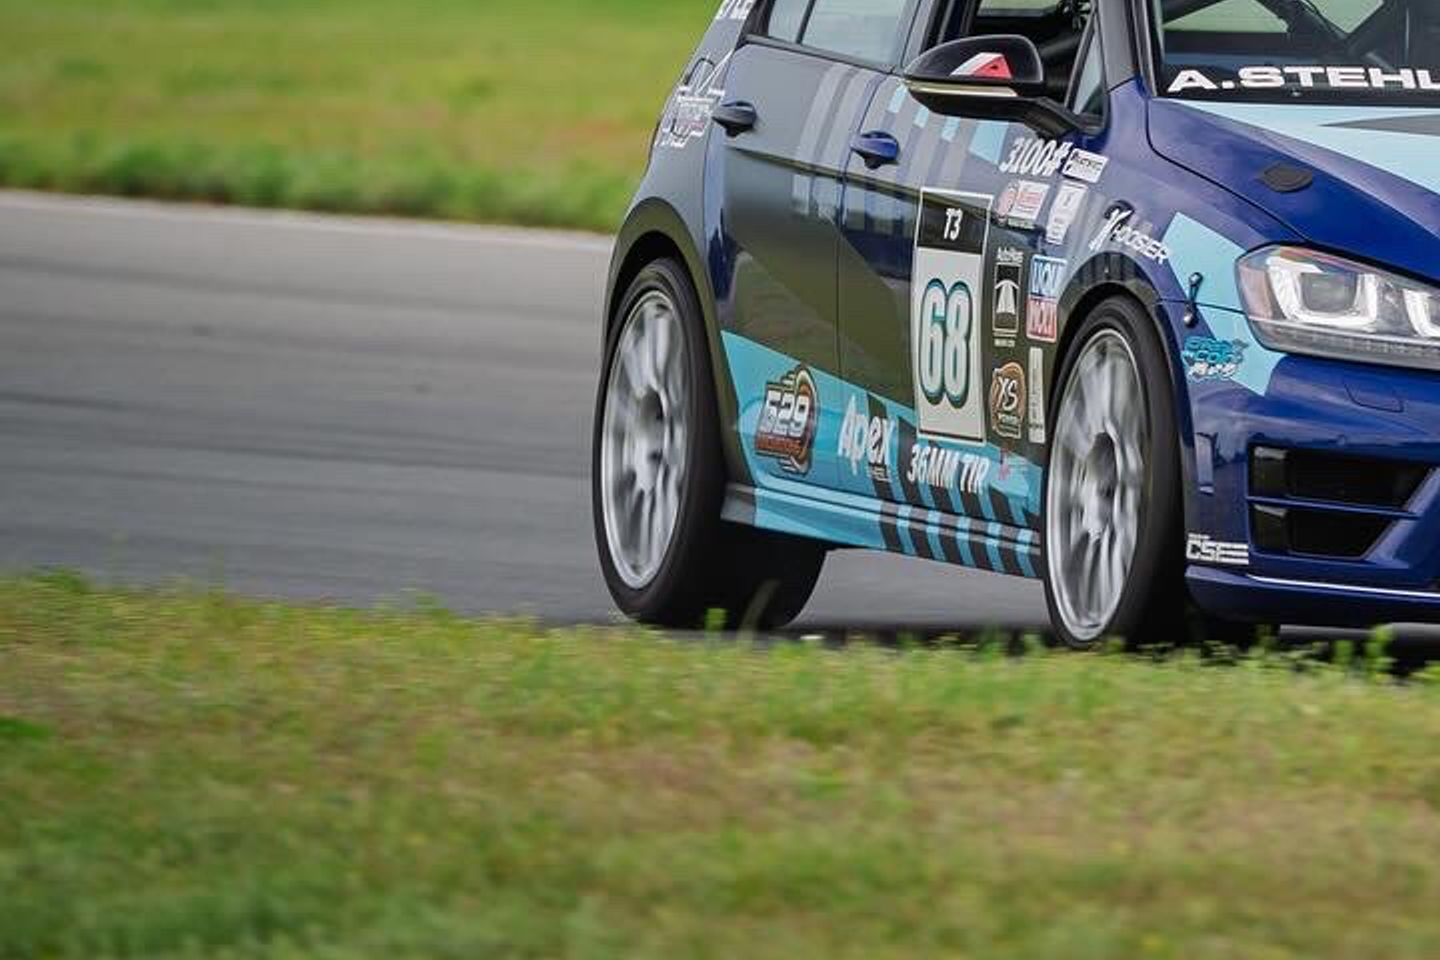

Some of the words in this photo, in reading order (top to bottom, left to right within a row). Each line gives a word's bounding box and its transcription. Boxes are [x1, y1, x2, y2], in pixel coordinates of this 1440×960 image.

[943, 207, 963, 240] T3
[919, 277, 973, 409] 68
[756, 389, 812, 438] 529
